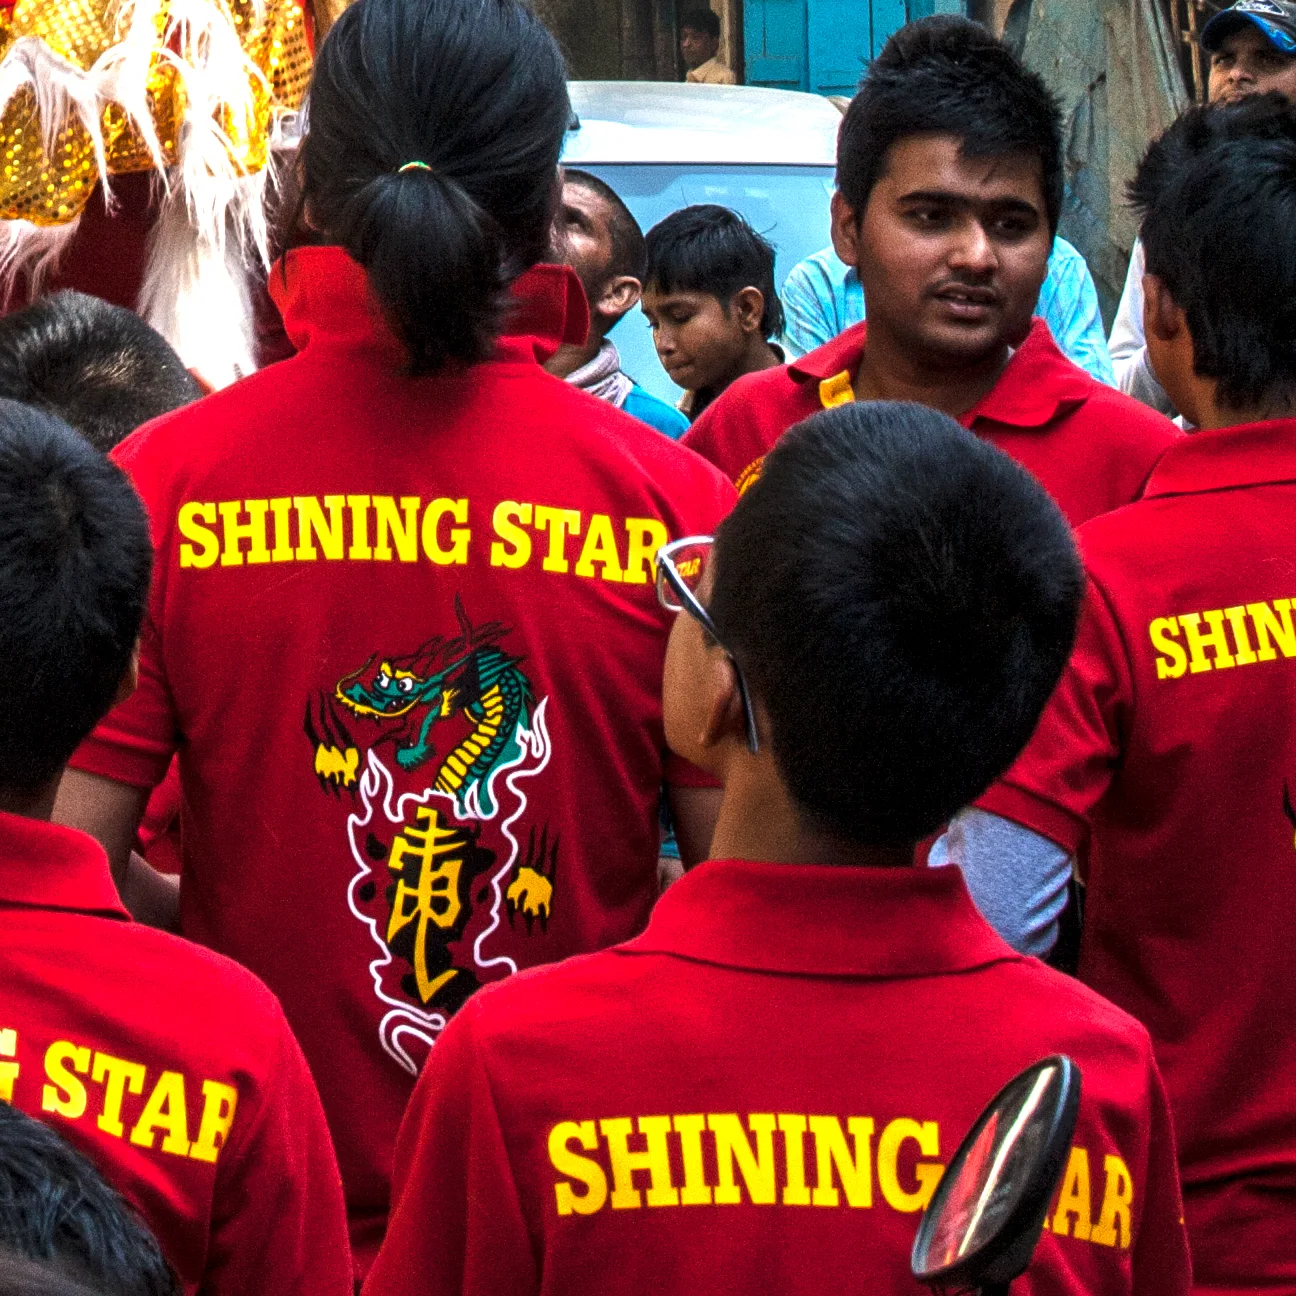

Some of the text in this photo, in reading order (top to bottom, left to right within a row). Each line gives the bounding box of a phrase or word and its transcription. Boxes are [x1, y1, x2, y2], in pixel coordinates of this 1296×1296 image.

[177, 494, 669, 585] SHINING STAR
[1148, 597, 1296, 680] SHIN
[547, 1112, 1133, 1249] SHINING AR
